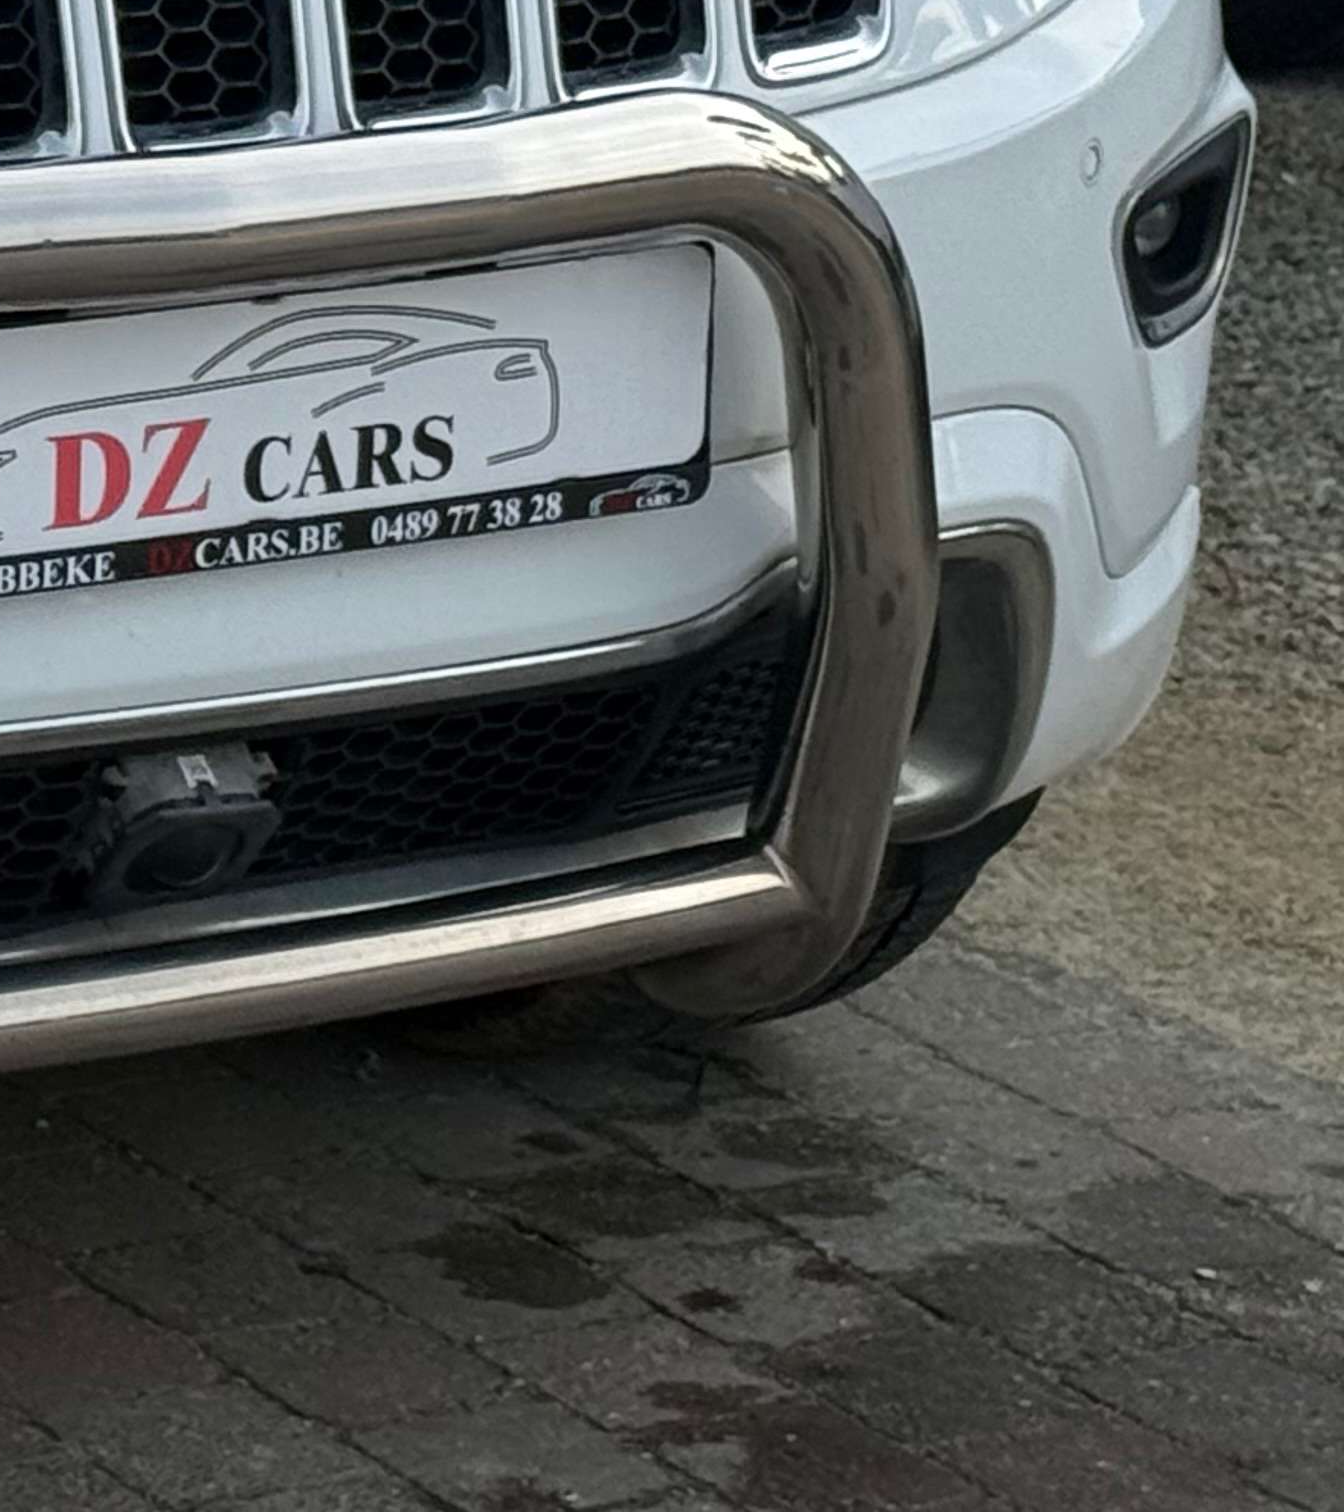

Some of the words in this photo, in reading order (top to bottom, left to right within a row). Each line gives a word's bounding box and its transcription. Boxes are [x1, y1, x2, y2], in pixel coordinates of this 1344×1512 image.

[42, 418, 211, 531] DZ
[243, 415, 455, 503] CARS
[371, 508, 439, 547] 0489
[446, 502, 482, 535] 77
[486, 497, 521, 530] 38
[528, 491, 563, 524] 28
